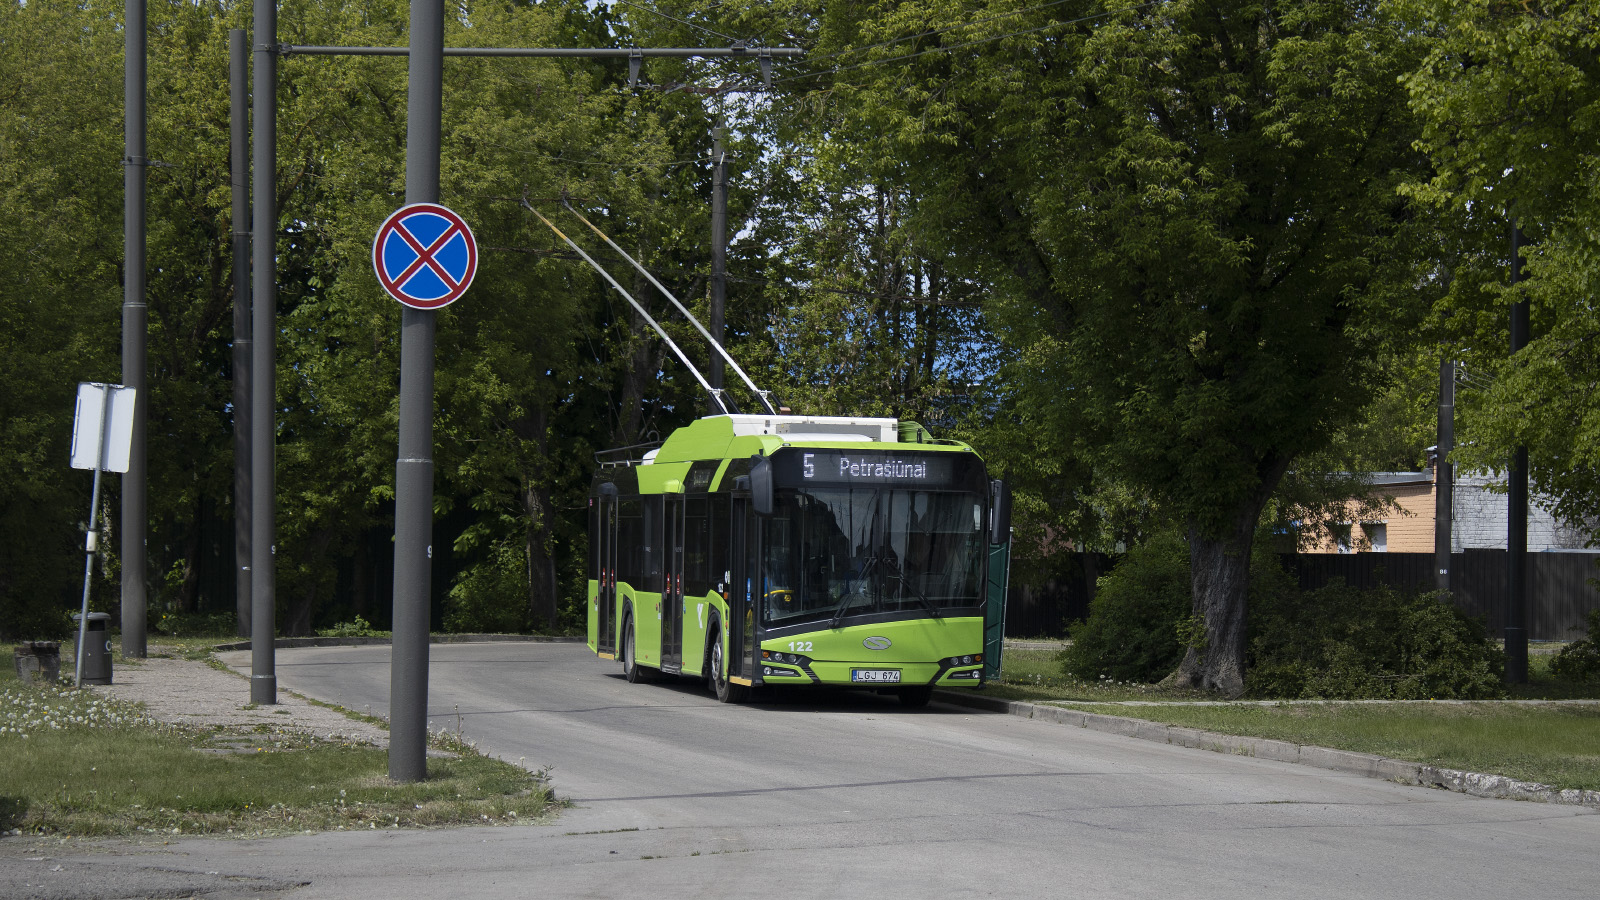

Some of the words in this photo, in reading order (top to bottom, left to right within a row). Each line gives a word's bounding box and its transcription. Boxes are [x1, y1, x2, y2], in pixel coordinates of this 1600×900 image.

[803, 453, 815, 478] 5
[839, 457, 926, 479] Petrašiūnai
[788, 641, 813, 652] 122
[857, 671, 877, 680] LGJ
[882, 671, 899, 680] 674
